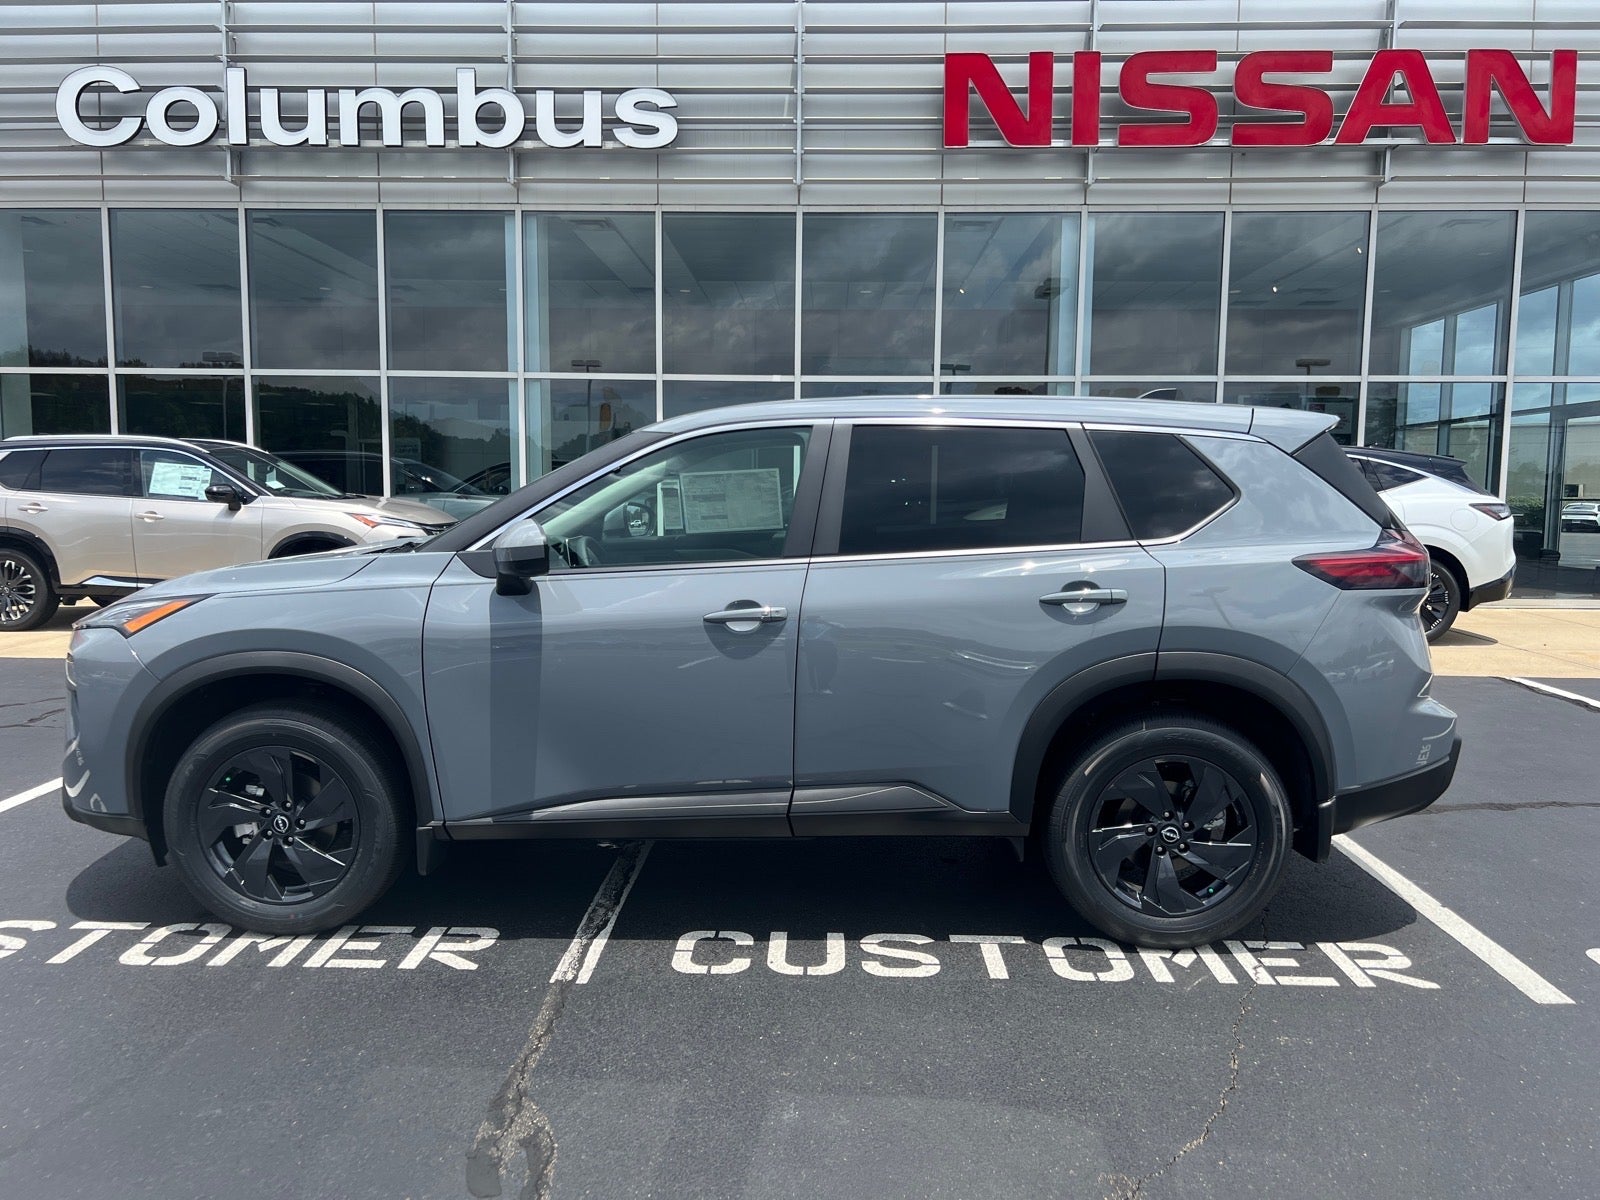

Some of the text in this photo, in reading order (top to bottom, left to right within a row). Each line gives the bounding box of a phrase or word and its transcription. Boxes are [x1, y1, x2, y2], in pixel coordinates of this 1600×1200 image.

[55, 65, 679, 149] Columbus
[943, 49, 1577, 148] NISSAN
[671, 930, 1441, 989] CUSTOMER
